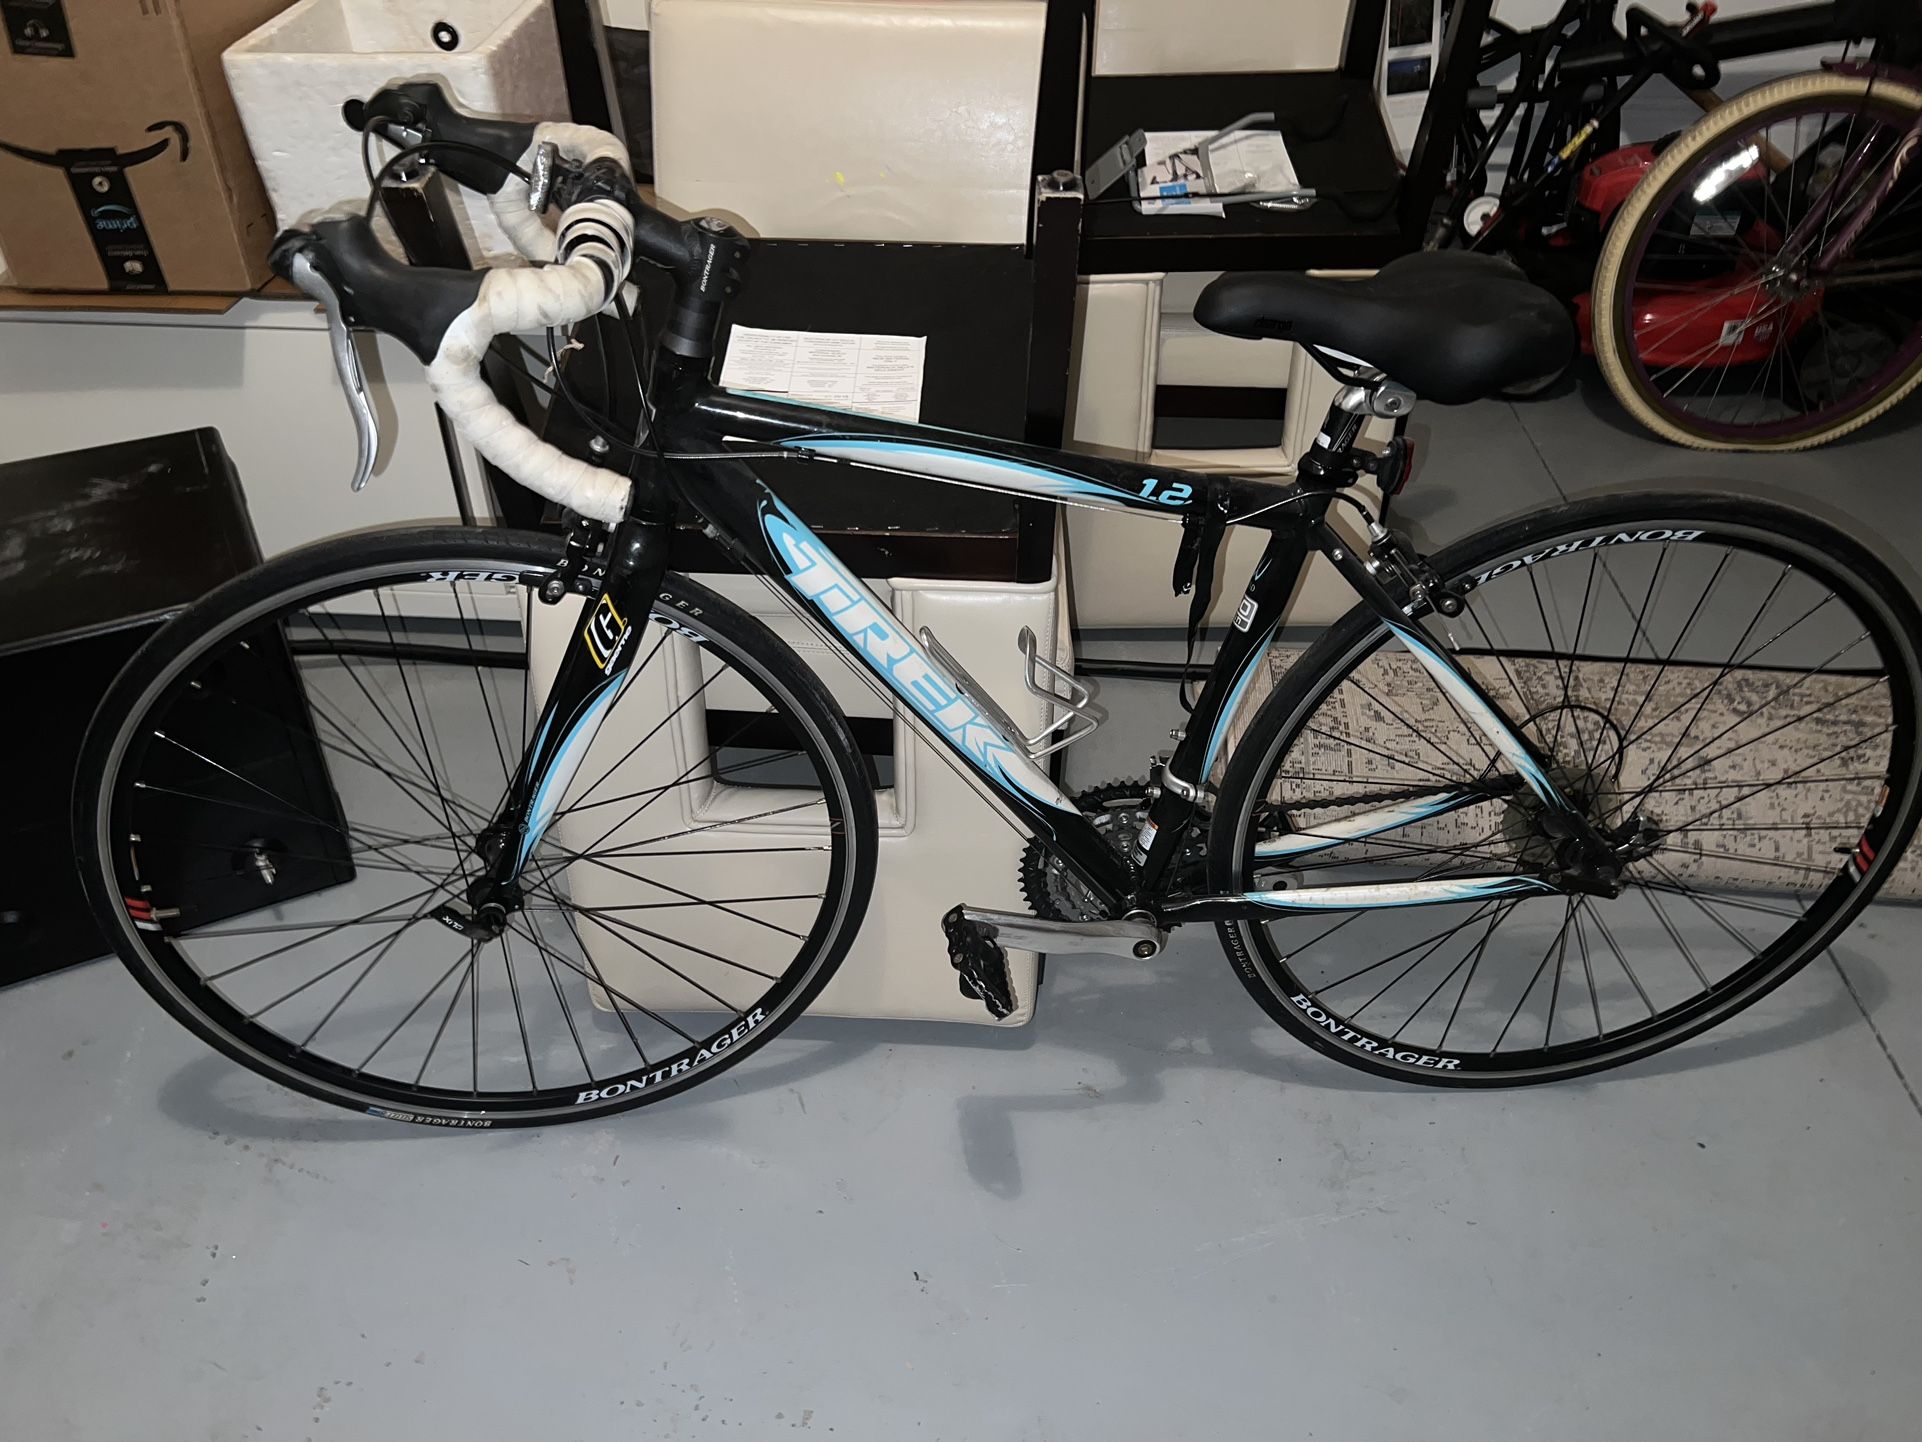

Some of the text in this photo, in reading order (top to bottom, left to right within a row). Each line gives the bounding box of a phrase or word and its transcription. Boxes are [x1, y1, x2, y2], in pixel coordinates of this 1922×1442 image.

[700, 243, 716, 293] BONTRAGER
[1139, 478, 1193, 506] 1.2
[782, 531, 1008, 771] TREK
[574, 1006, 769, 1105] BONTRAGER
[1289, 992, 1462, 1071] BONTRAGER
[415, 1116, 492, 1128] BONTRAGER
